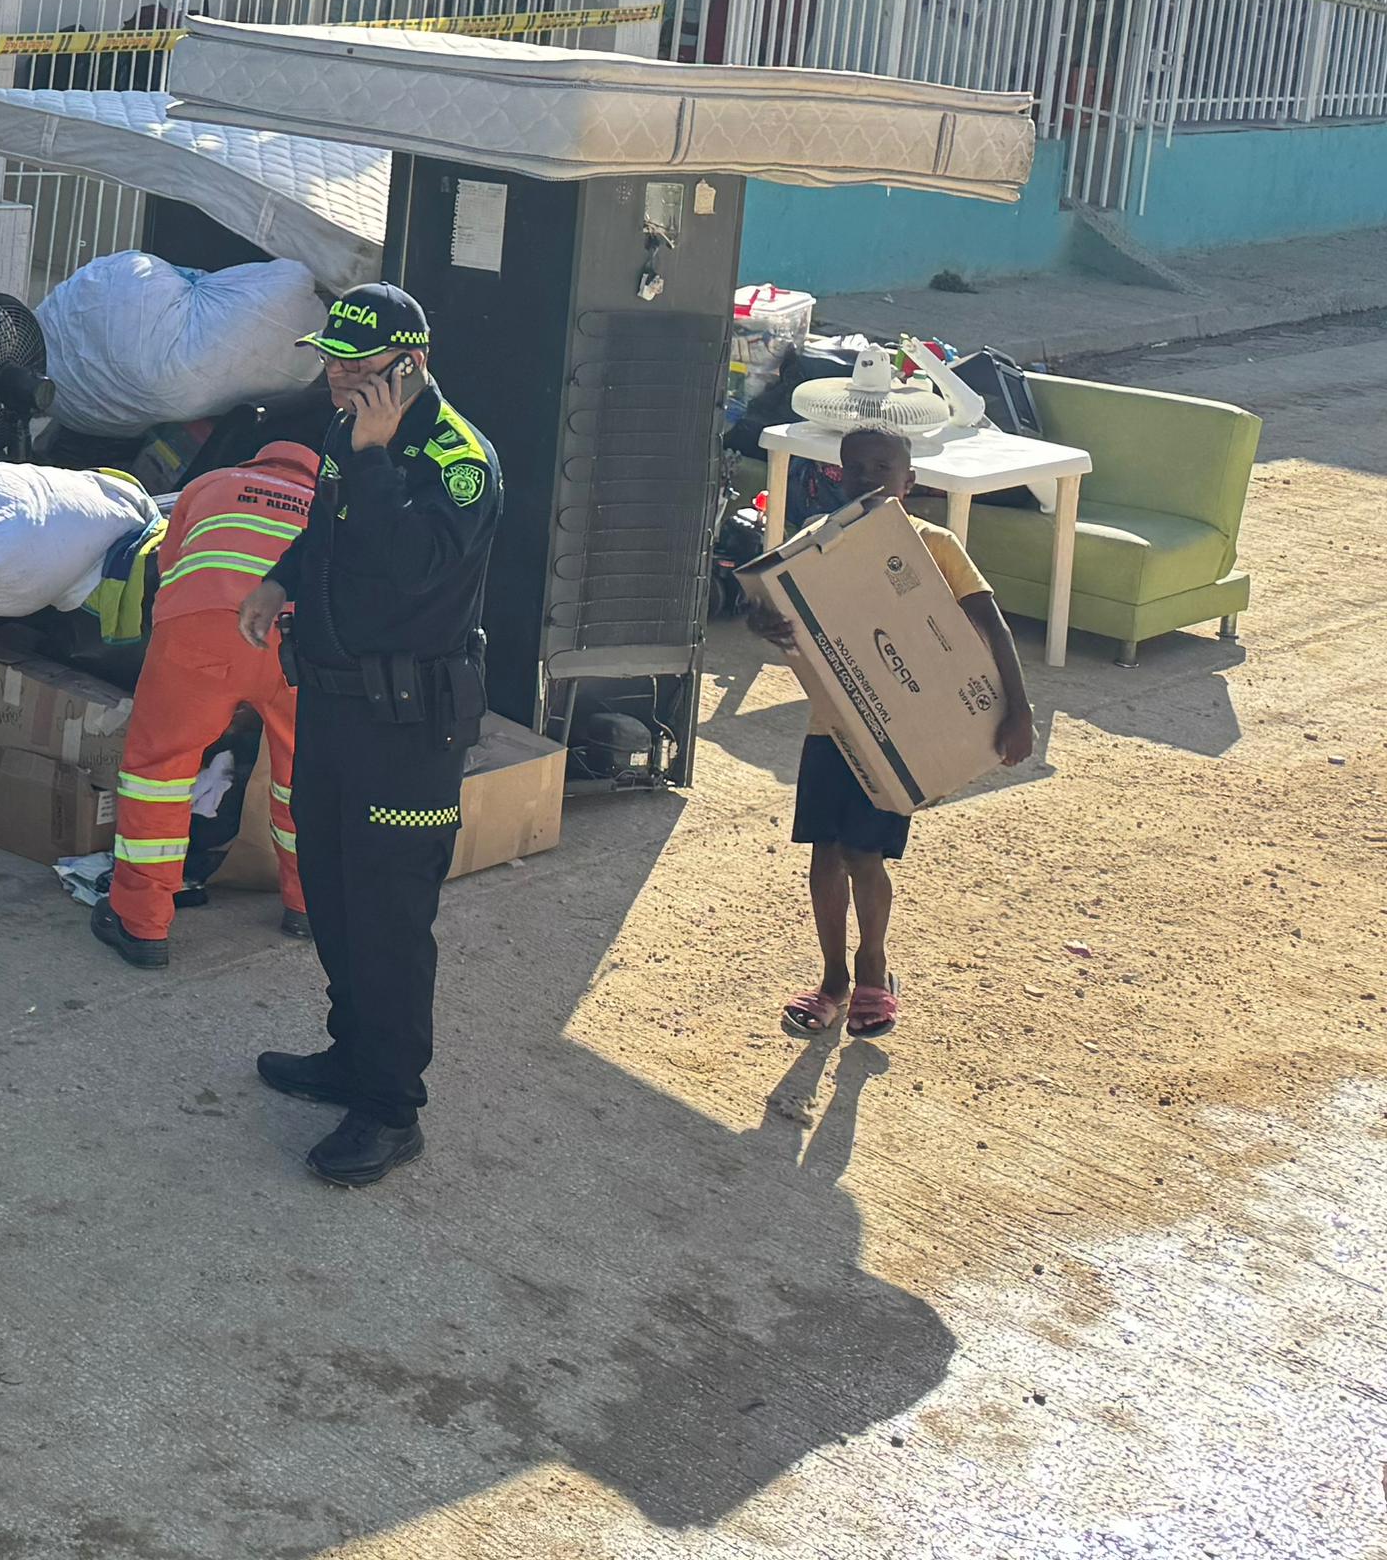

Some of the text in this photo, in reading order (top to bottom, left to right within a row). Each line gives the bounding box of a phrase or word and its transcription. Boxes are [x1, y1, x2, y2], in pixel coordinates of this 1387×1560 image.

[266, 500, 309, 516] ALCAL
[833, 636, 855, 665] STOVE
[838, 670, 856, 691] DOS
[879, 642, 921, 696] abba
[850, 664, 879, 701] BURNER
[874, 701, 891, 722] TWO
